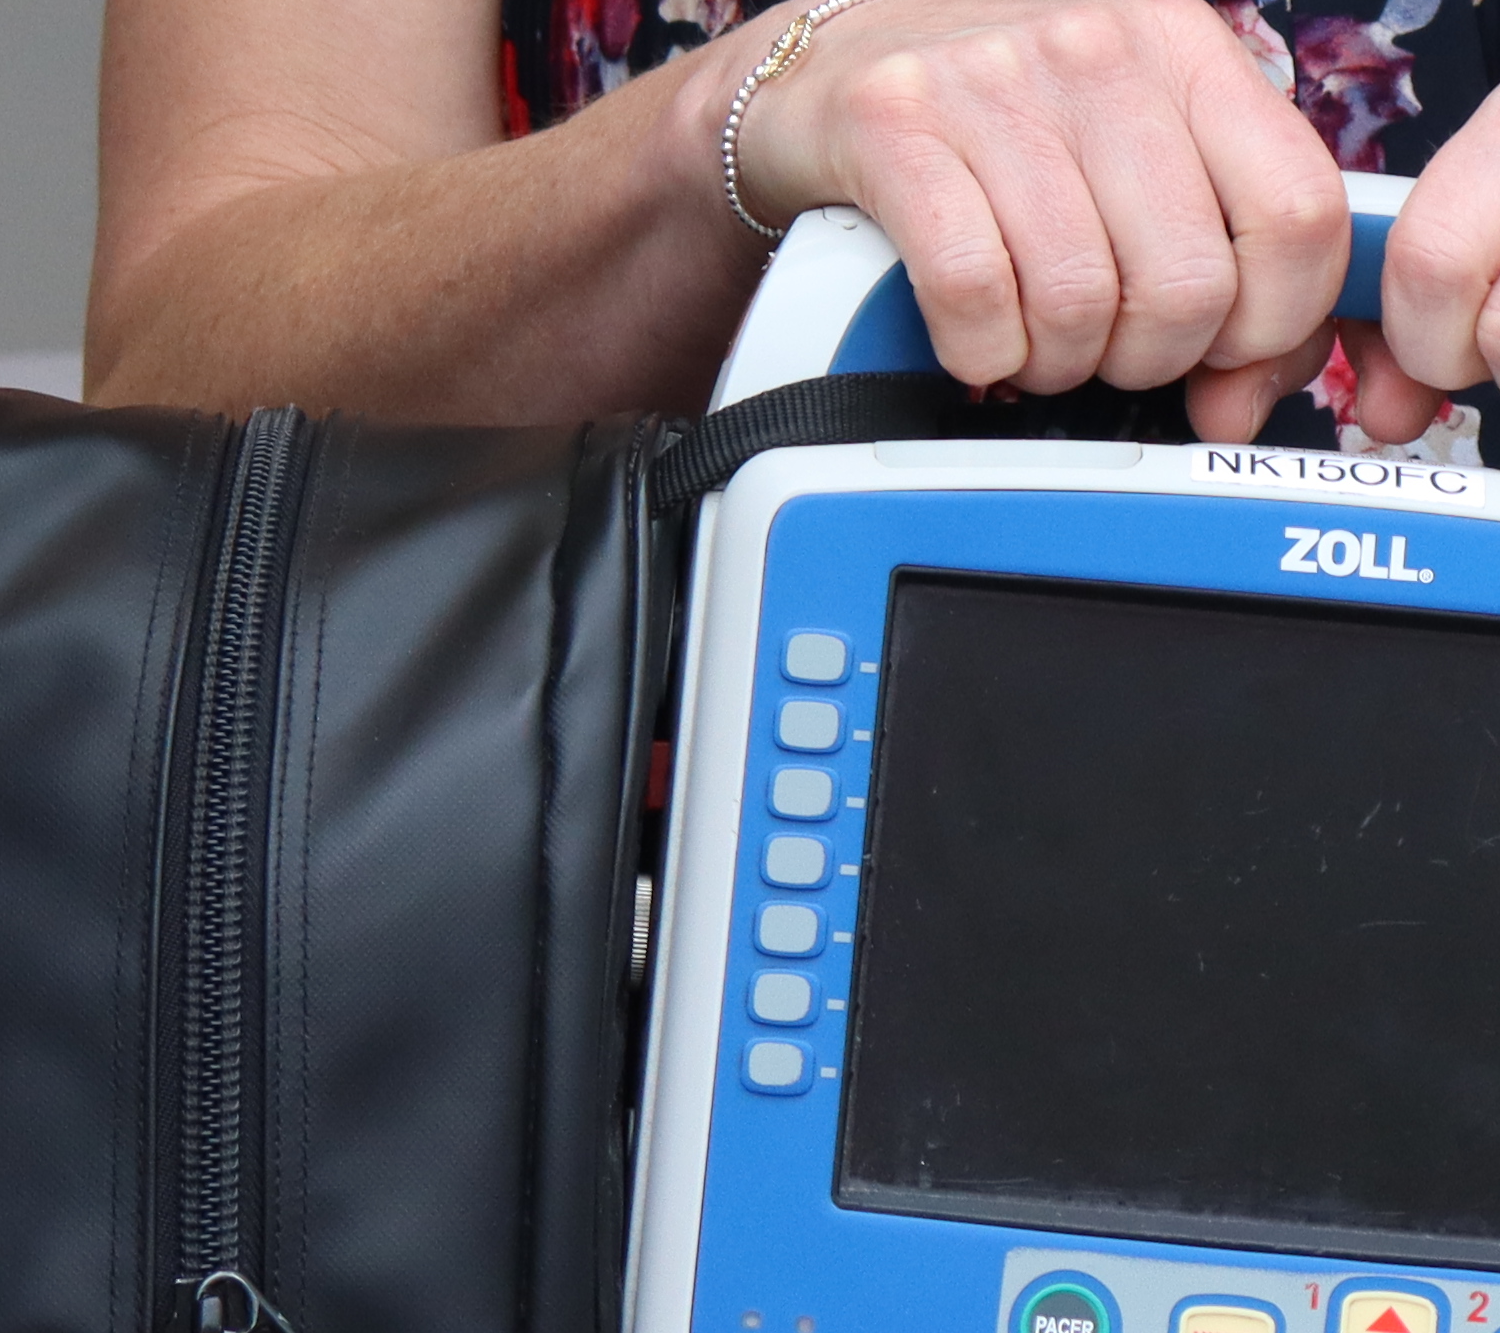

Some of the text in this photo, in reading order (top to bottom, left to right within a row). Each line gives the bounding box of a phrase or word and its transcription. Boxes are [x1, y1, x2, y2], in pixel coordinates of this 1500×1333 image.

[1304, 1281, 1321, 1311] 1
[1465, 1290, 1491, 1324] 2
[1034, 1314, 1095, 1333] PACER
